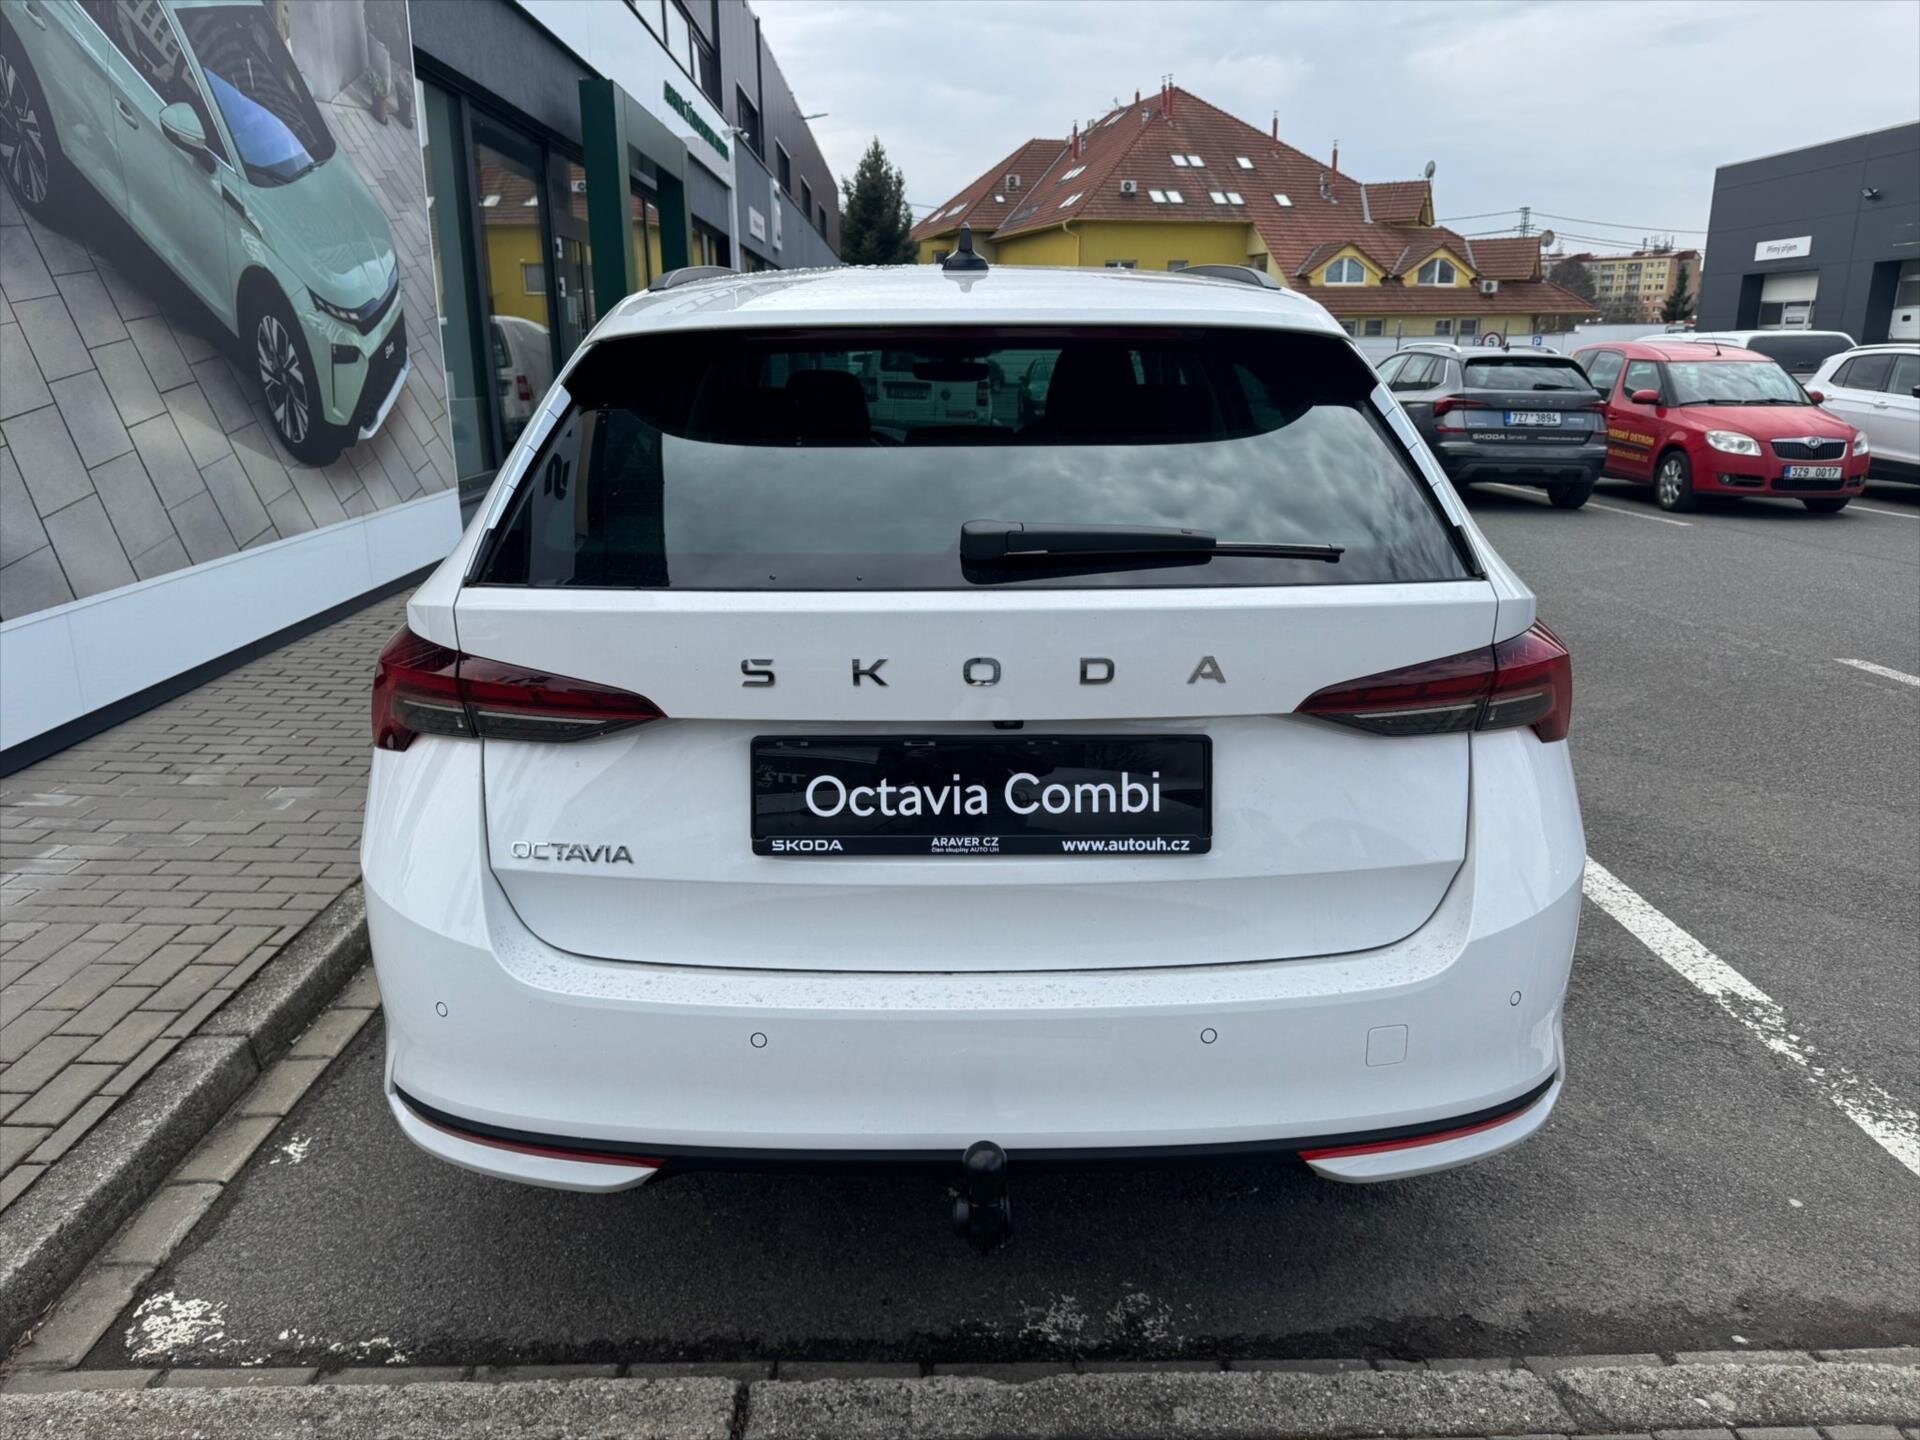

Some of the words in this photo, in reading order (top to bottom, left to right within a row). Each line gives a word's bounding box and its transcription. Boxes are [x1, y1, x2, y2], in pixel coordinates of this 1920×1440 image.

[1513, 412, 1529, 423] 7Z7
[1535, 412, 1557, 423] 3894
[1792, 467, 1810, 478] 3Z9
[1815, 467, 1838, 478] 0017
[804, 773, 988, 818] Octavia
[1004, 770, 1161, 815] Combi
[931, 837, 980, 847] ARAVER
[983, 837, 999, 847] CZ
[1062, 837, 1190, 853] www.autouh.cz
[511, 840, 635, 865] OCTAVIA
